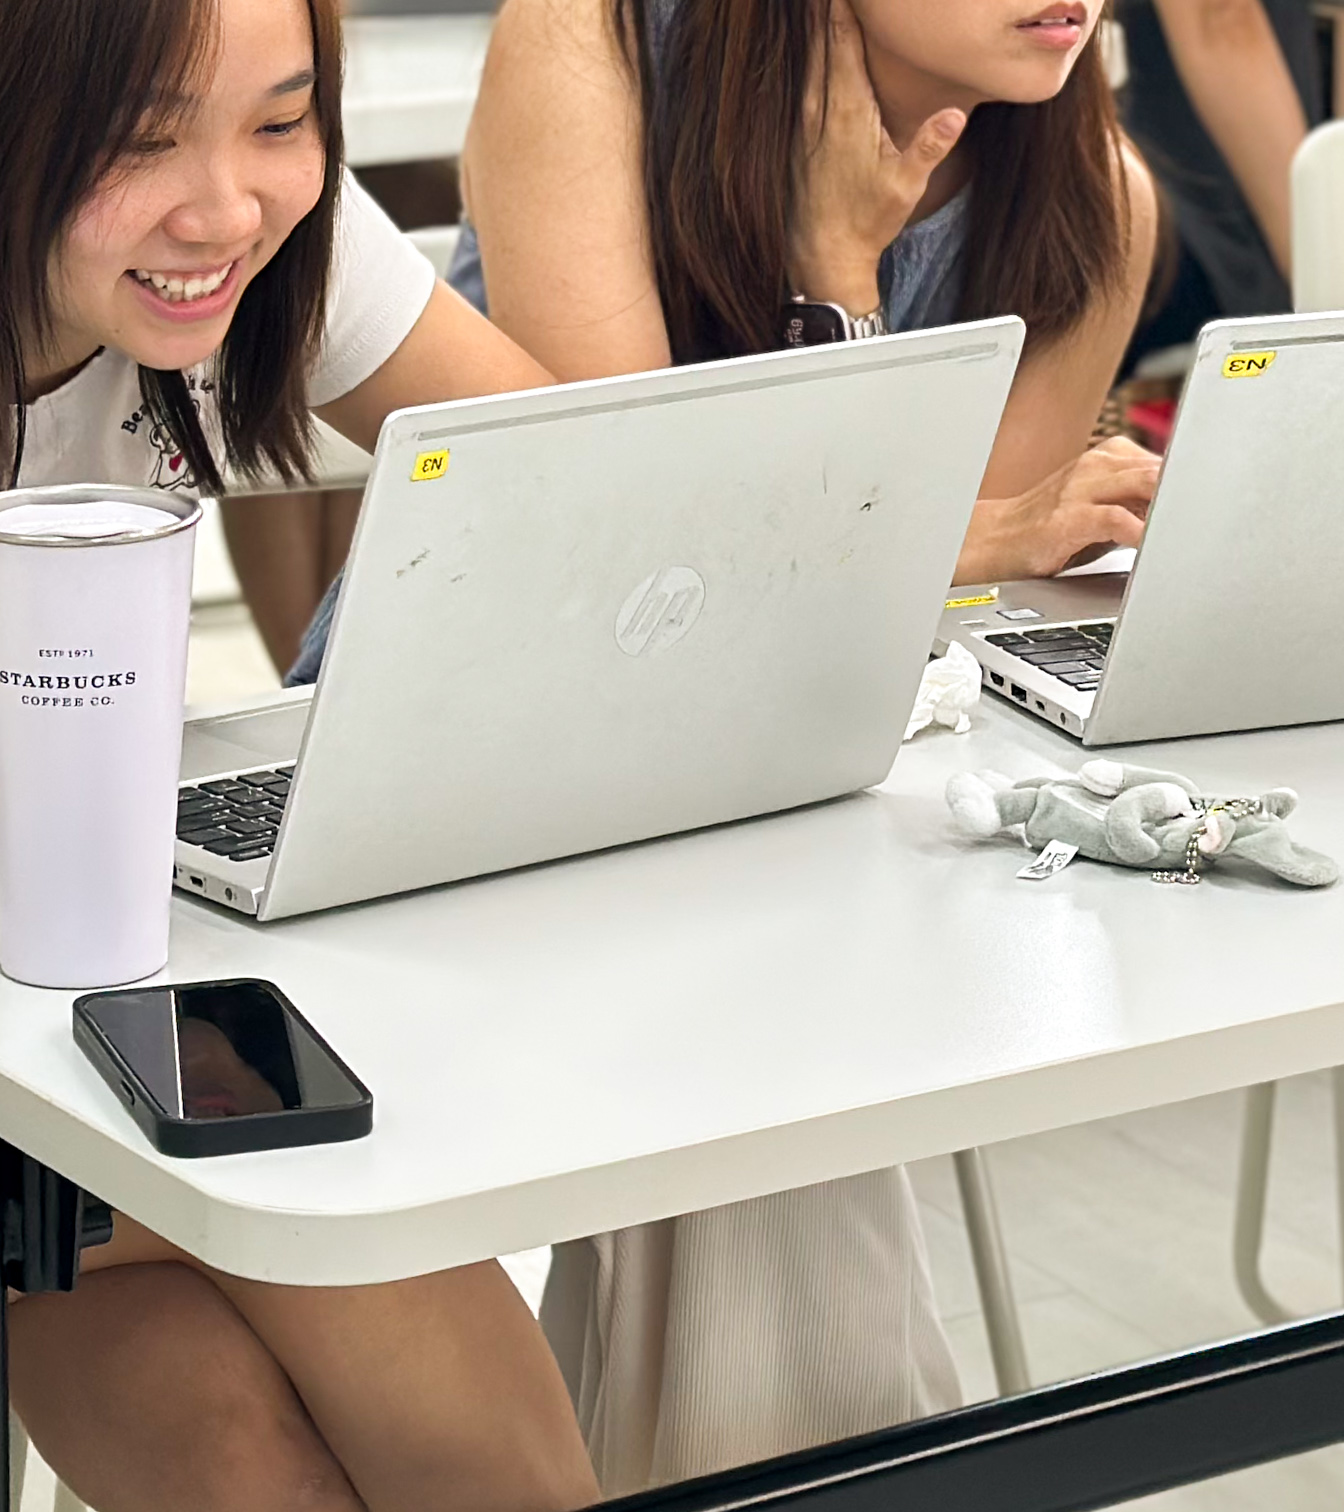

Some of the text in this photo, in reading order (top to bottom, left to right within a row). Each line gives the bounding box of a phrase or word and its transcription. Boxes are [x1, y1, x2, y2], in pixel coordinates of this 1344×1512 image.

[68, 649, 94, 658] 1971
[0, 670, 136, 690] STARBUCKS
[21, 695, 84, 707] COFFEE
